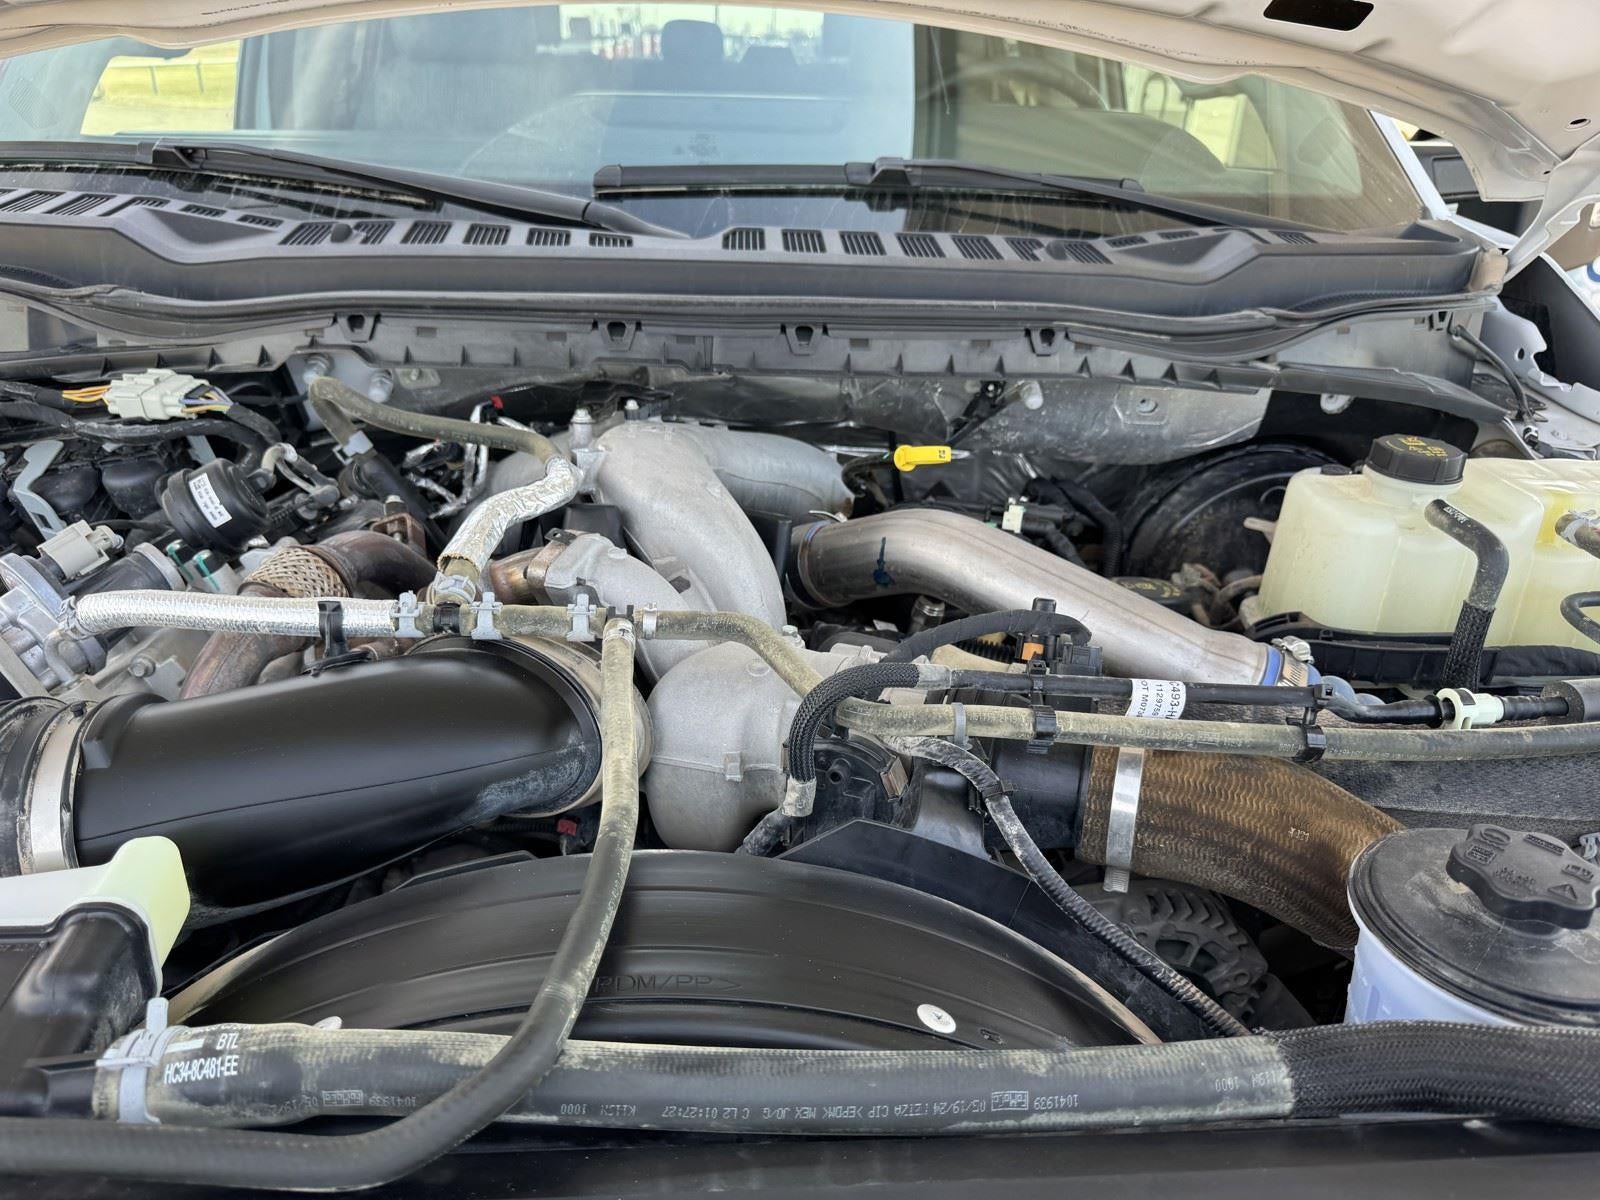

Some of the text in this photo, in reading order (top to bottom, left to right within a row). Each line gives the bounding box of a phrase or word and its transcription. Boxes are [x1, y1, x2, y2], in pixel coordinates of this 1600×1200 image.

[215, 1032, 240, 1050] BTL
[163, 1054, 240, 1085] HC34-8C481-EE
[560, 1102, 587, 1116] 1000
[1033, 1093, 1079, 1110] 1041939
[661, 1104, 718, 1119] 01:27:27
[722, 1106, 738, 1119] L2
[742, 1106, 750, 1119] C
[794, 1105, 817, 1120] MEX
[867, 1104, 889, 1119] CIP
